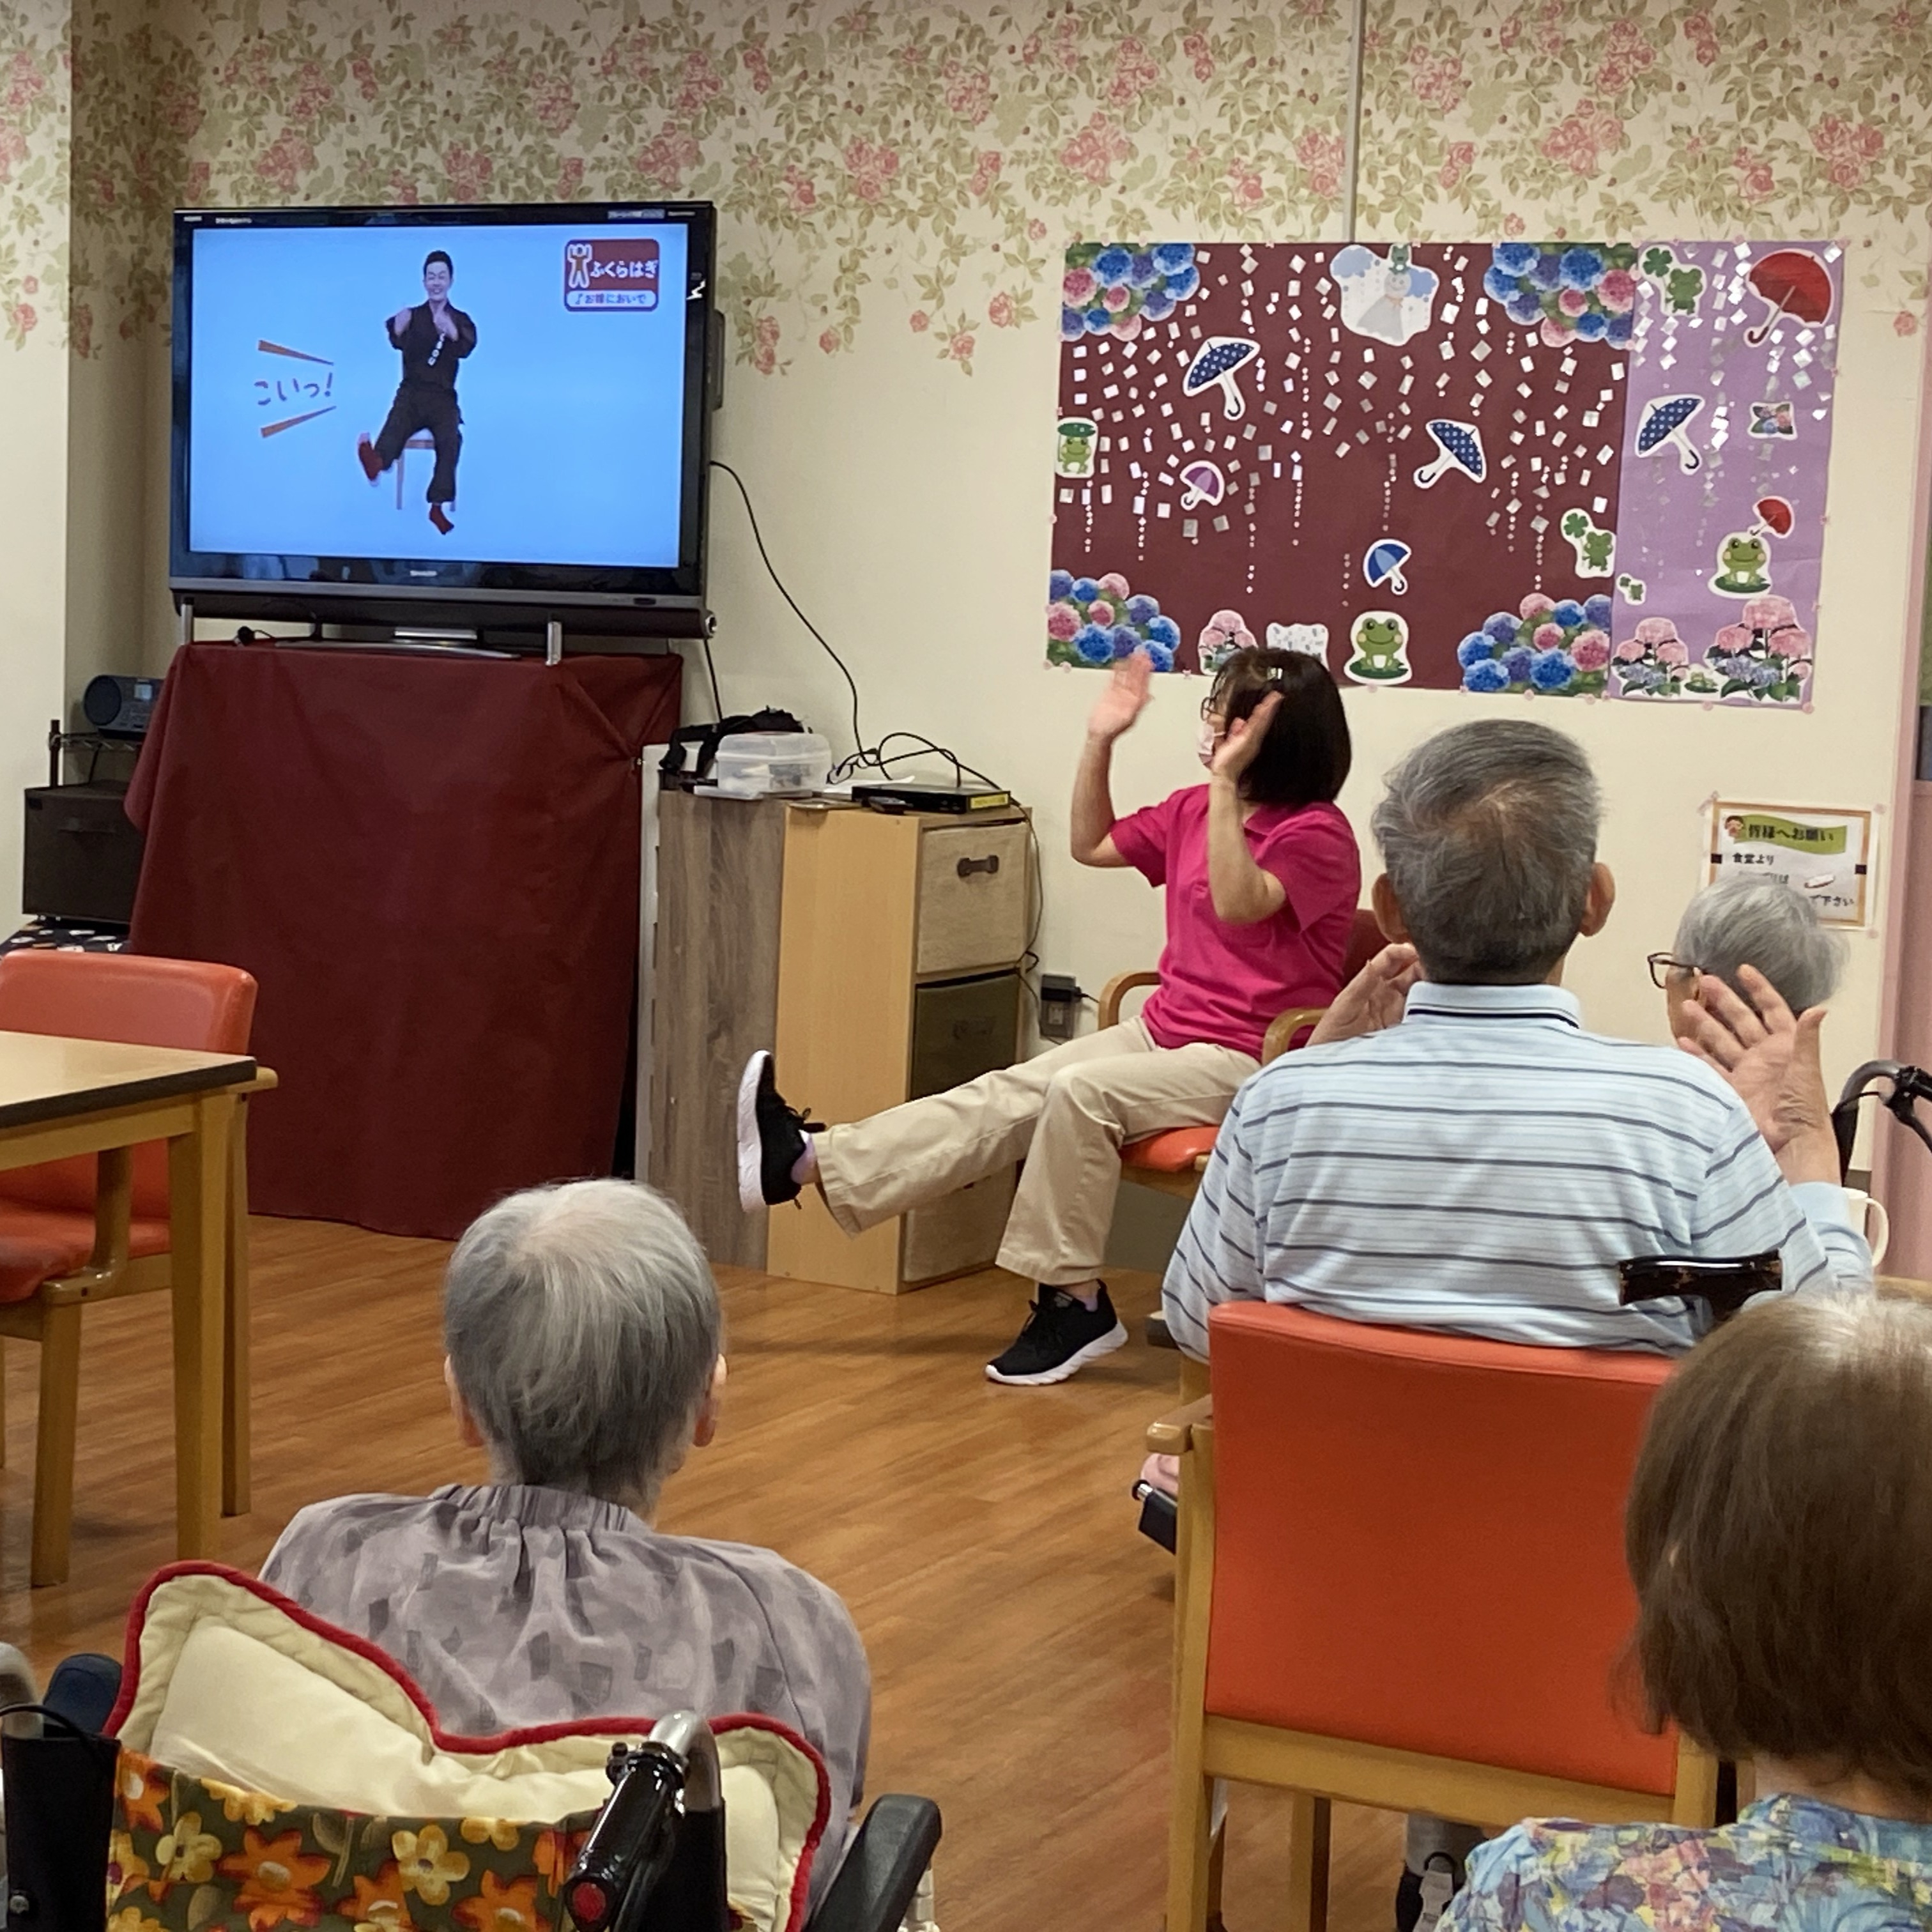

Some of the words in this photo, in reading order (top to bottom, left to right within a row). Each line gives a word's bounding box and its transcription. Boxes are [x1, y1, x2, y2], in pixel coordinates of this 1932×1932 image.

[590, 259, 658, 278] ふくらはぎ
[1732, 852, 1774, 865] 食堂より
